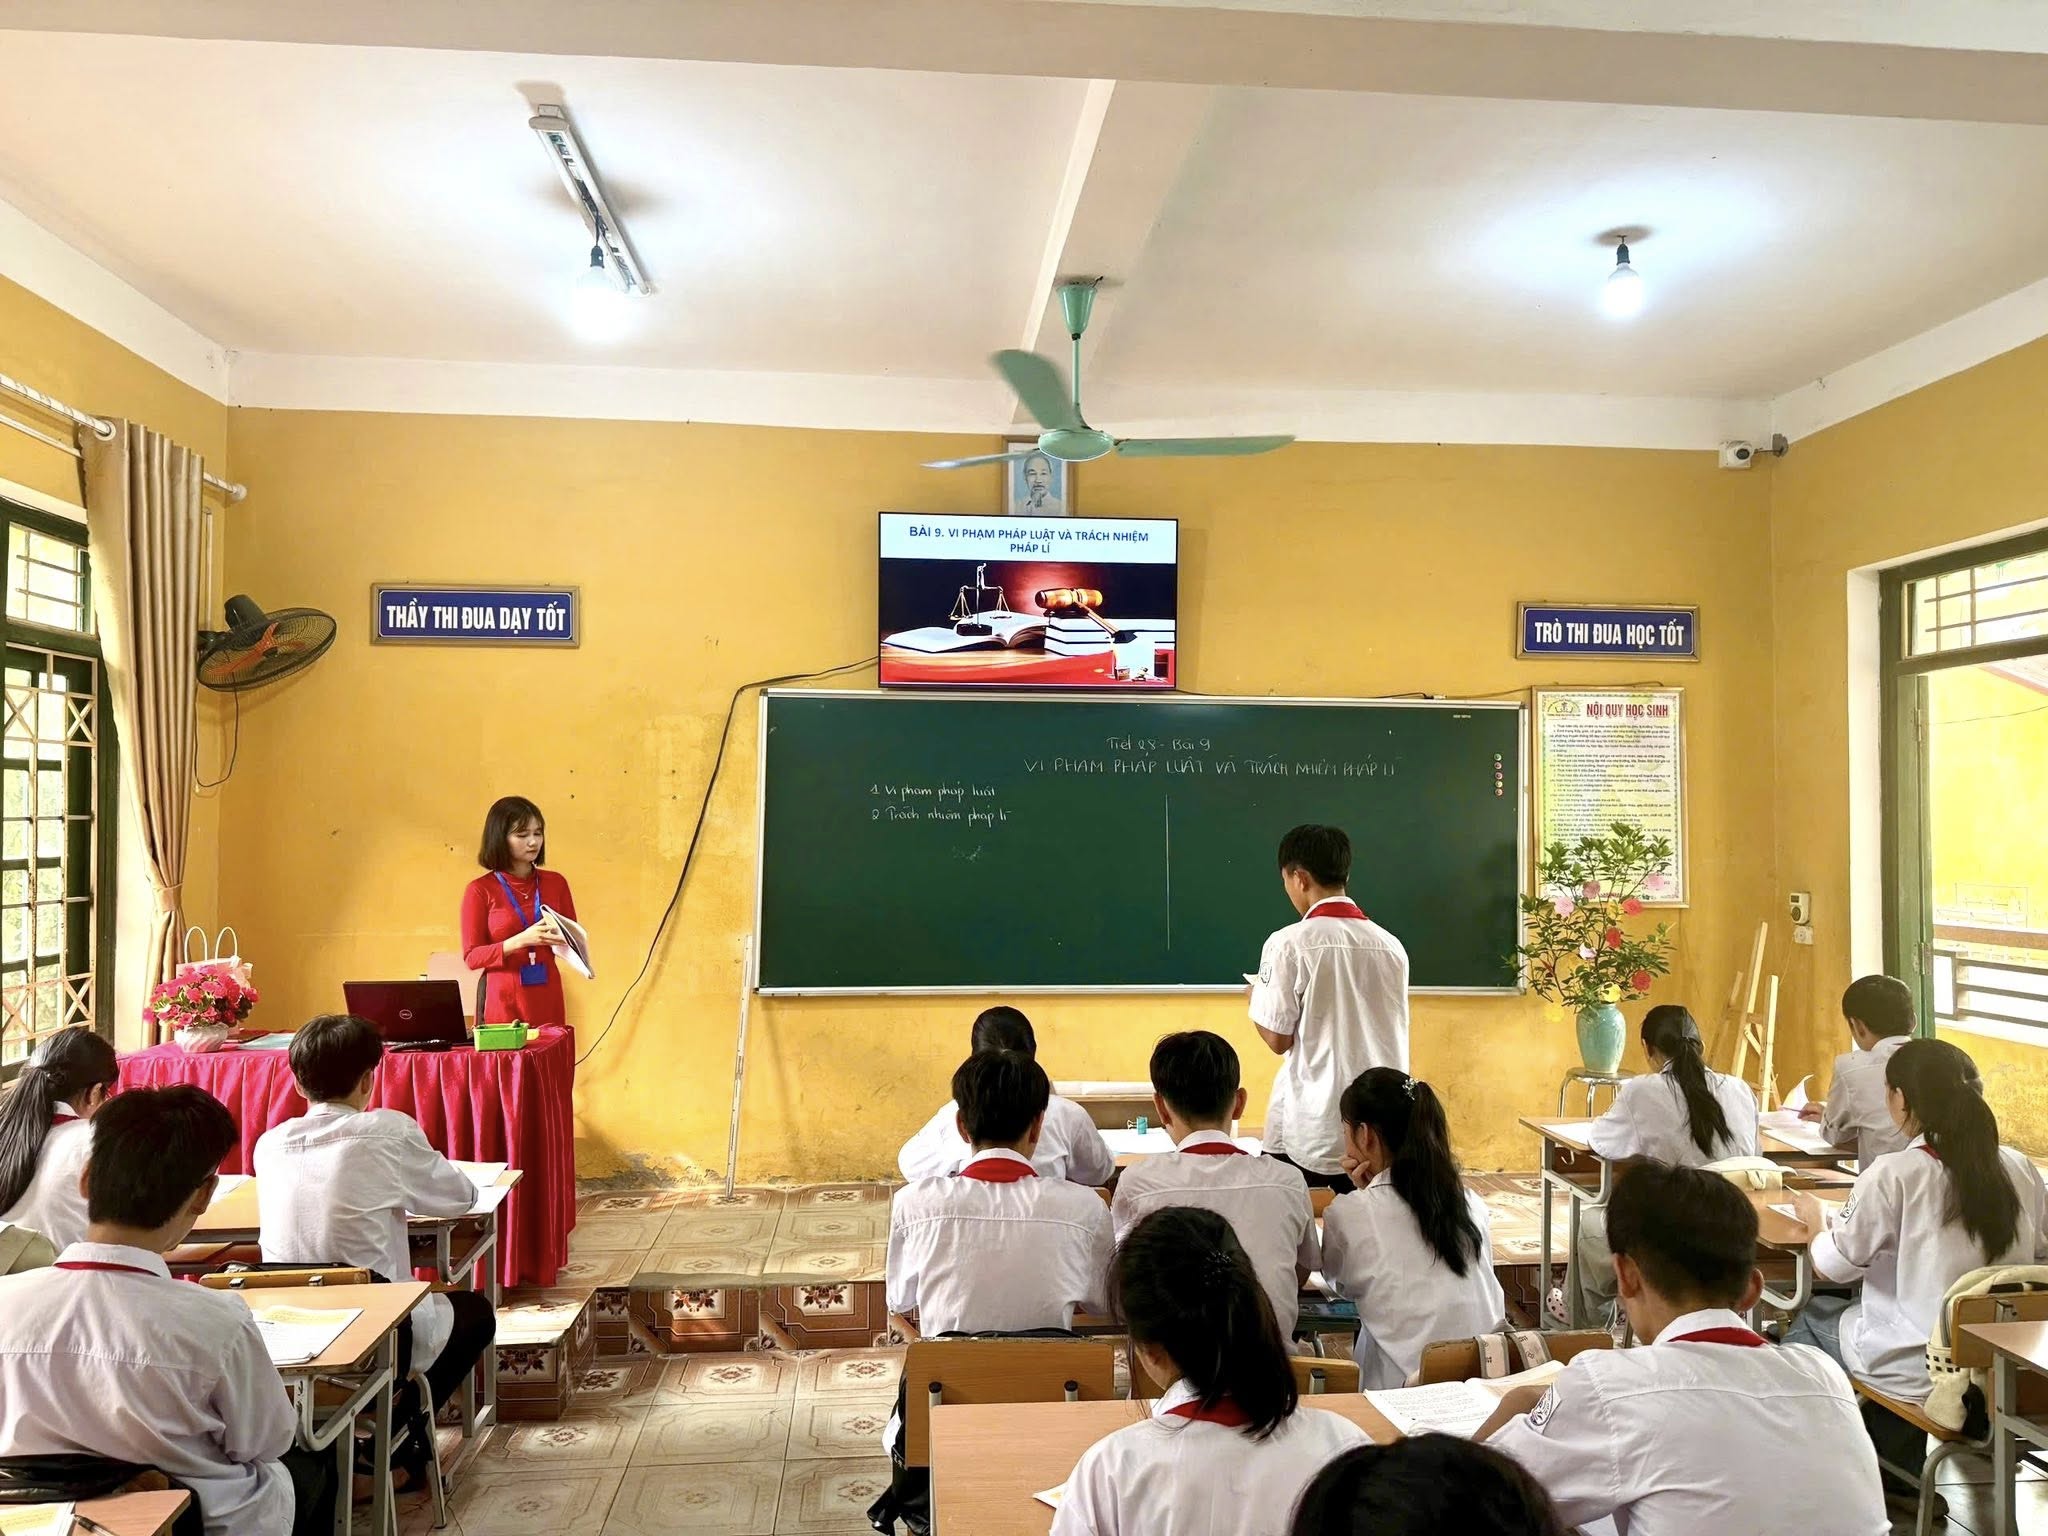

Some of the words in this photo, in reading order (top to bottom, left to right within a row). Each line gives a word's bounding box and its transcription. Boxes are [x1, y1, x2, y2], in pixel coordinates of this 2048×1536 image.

[909, 524, 931, 537] BÀI
[935, 528, 944, 537] 9.
[948, 528, 959, 537] VI
[962, 529, 995, 540] PHẠM
[998, 528, 1027, 539] PHÁP
[1030, 528, 1055, 541] LUẬT
[1058, 529, 1072, 540] VÀ
[1075, 529, 1110, 541] TRÁCH
[1113, 530, 1149, 543] NHIỆM
[1010, 541, 1039, 553] PHÁP
[1041, 542, 1050, 553] LÍ
[386, 598, 428, 628] THẦY
[432, 606, 458, 629] THI
[462, 606, 495, 630] ĐUA
[500, 607, 532, 634] DẠY
[537, 601, 566, 631] TỐT
[1535, 618, 1562, 643] TRÒ
[1566, 622, 1588, 644] THI
[1593, 623, 1622, 645] ĐUA
[1626, 624, 1655, 649] HỌC
[1659, 618, 1685, 646] TỐT
[1586, 701, 1603, 719] NỘI
[1605, 704, 1623, 717] QUY
[1626, 704, 1644, 719] HỌC
[1646, 704, 1669, 717] SINH
[1199, 738, 1211, 750] 9
[1023, 758, 1044, 772] VI
